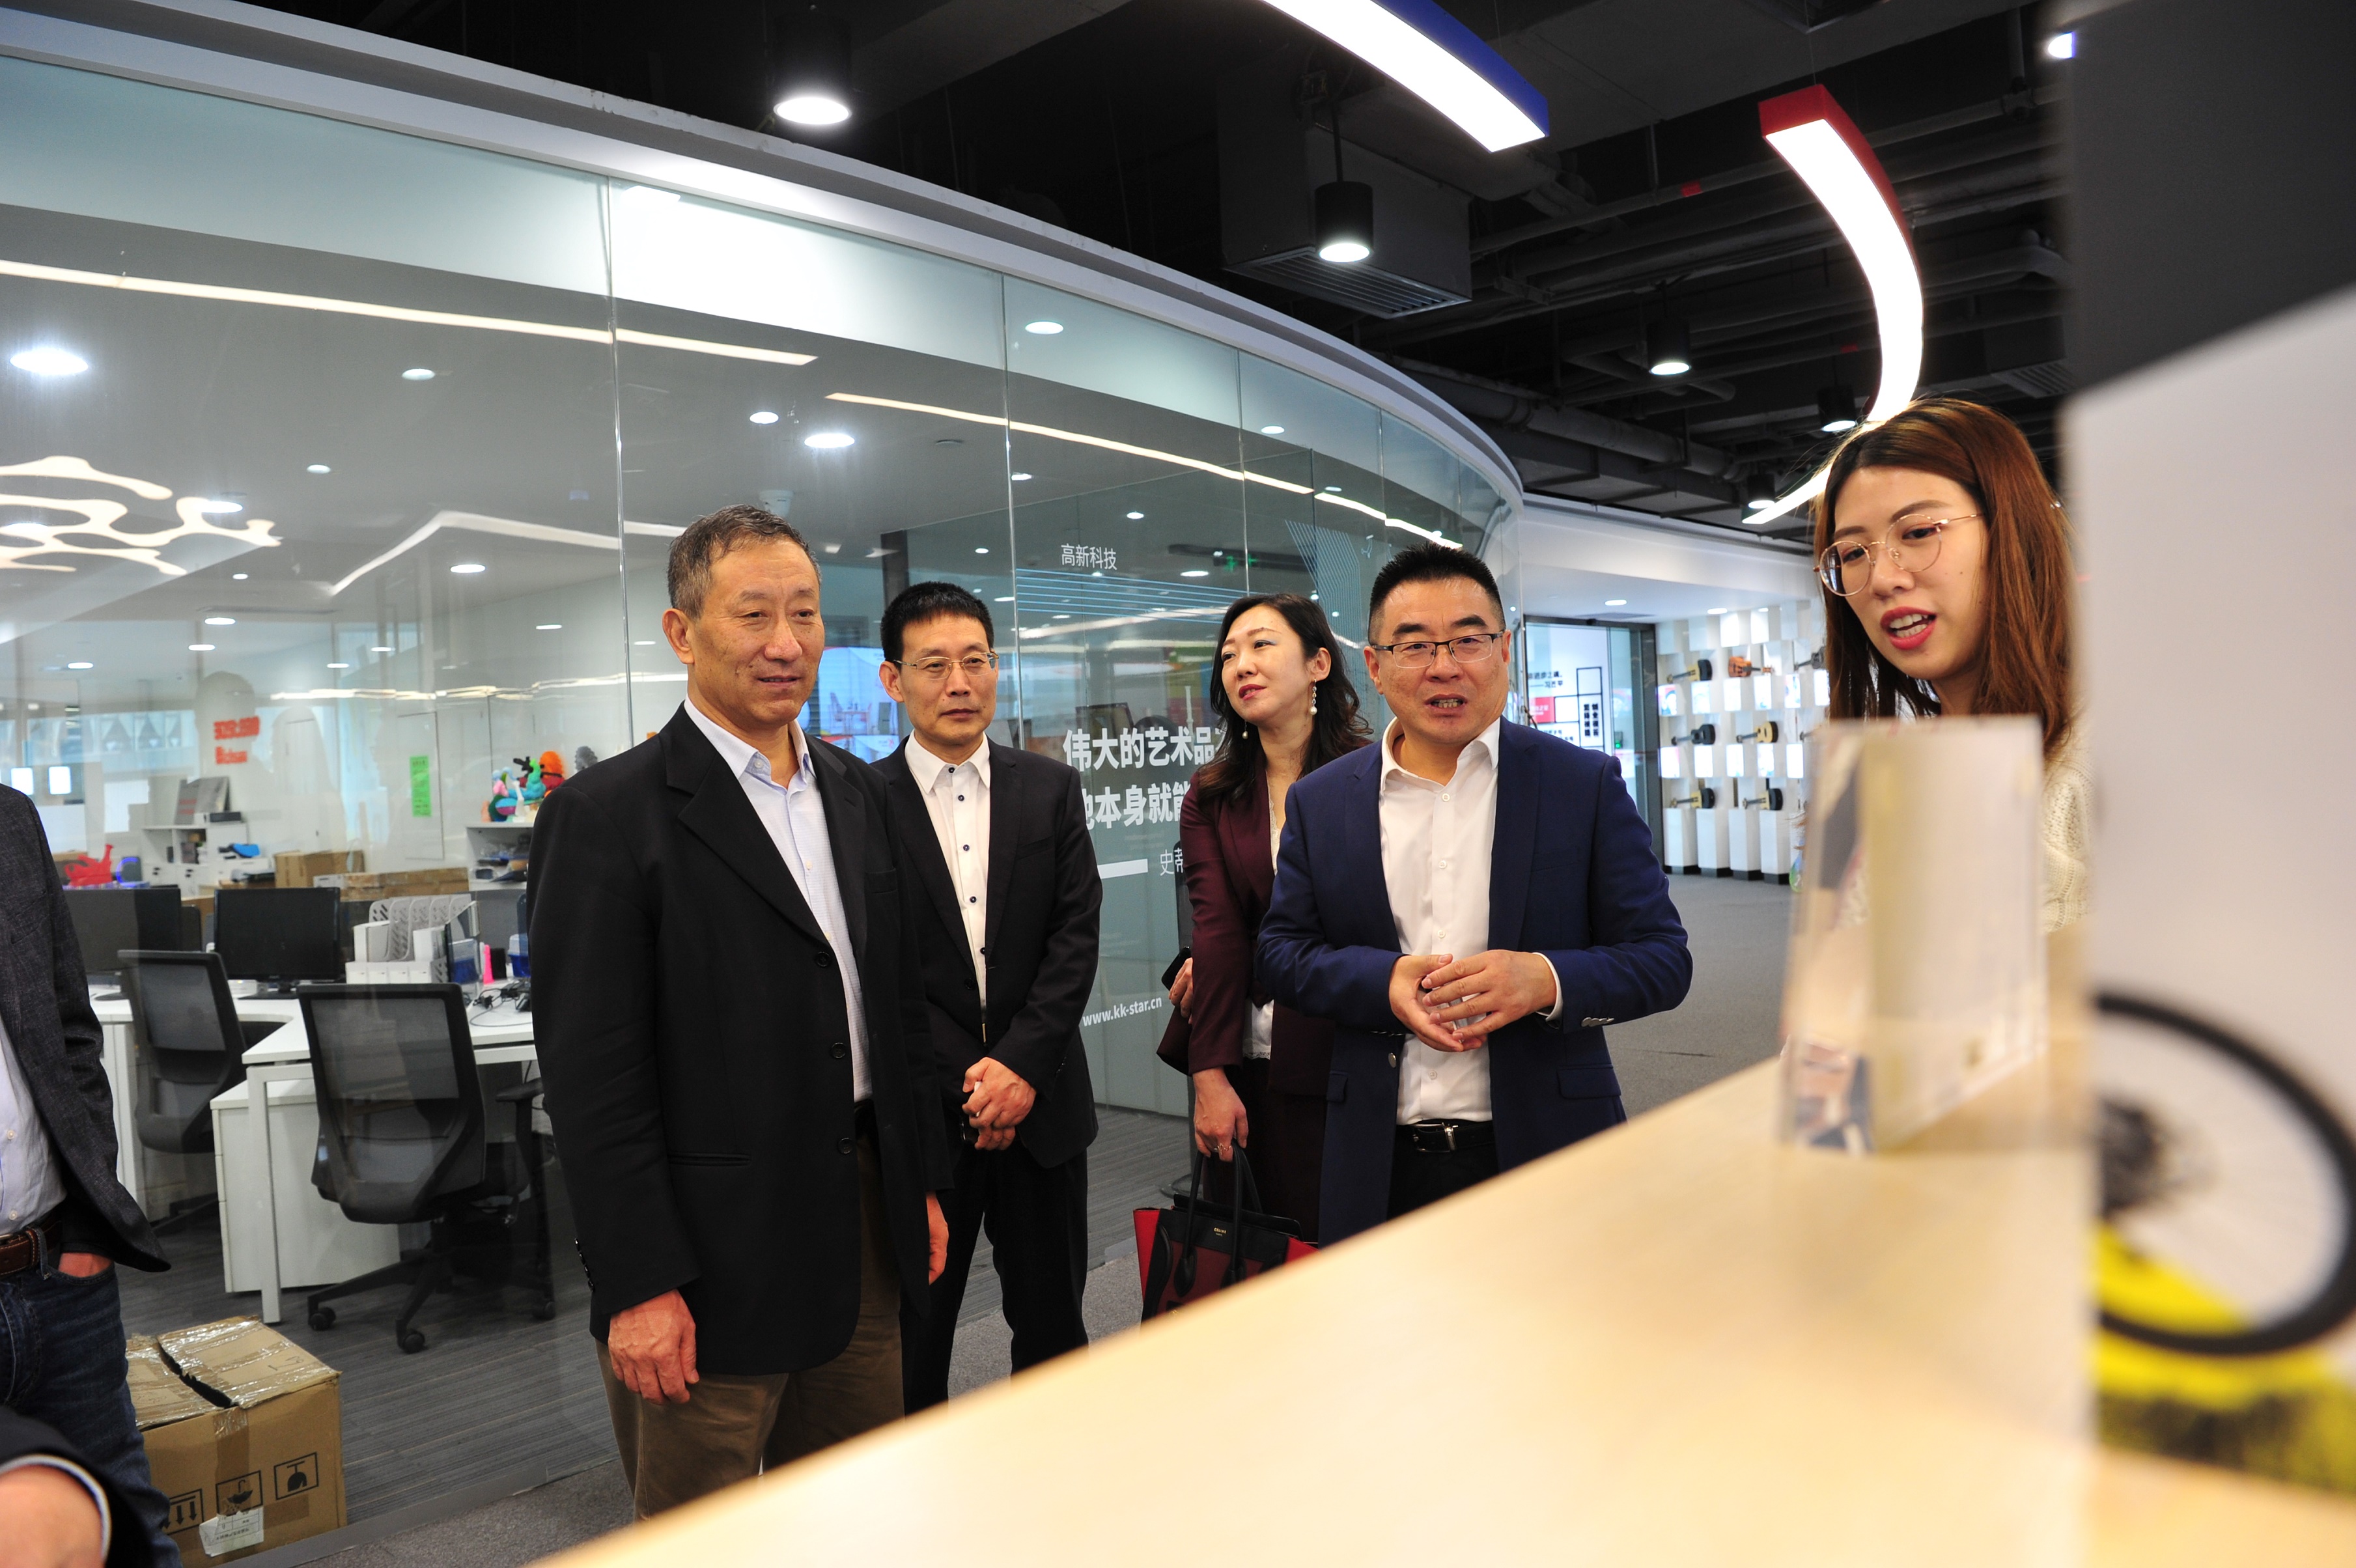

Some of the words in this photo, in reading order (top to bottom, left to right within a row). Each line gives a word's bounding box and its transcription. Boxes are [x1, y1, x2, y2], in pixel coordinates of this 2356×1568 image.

[1061, 543, 1117, 570] 高新科技
[1063, 726, 1225, 772] 伟大的艺术品
[1082, 997, 1162, 1027] www.kk-star.cn
